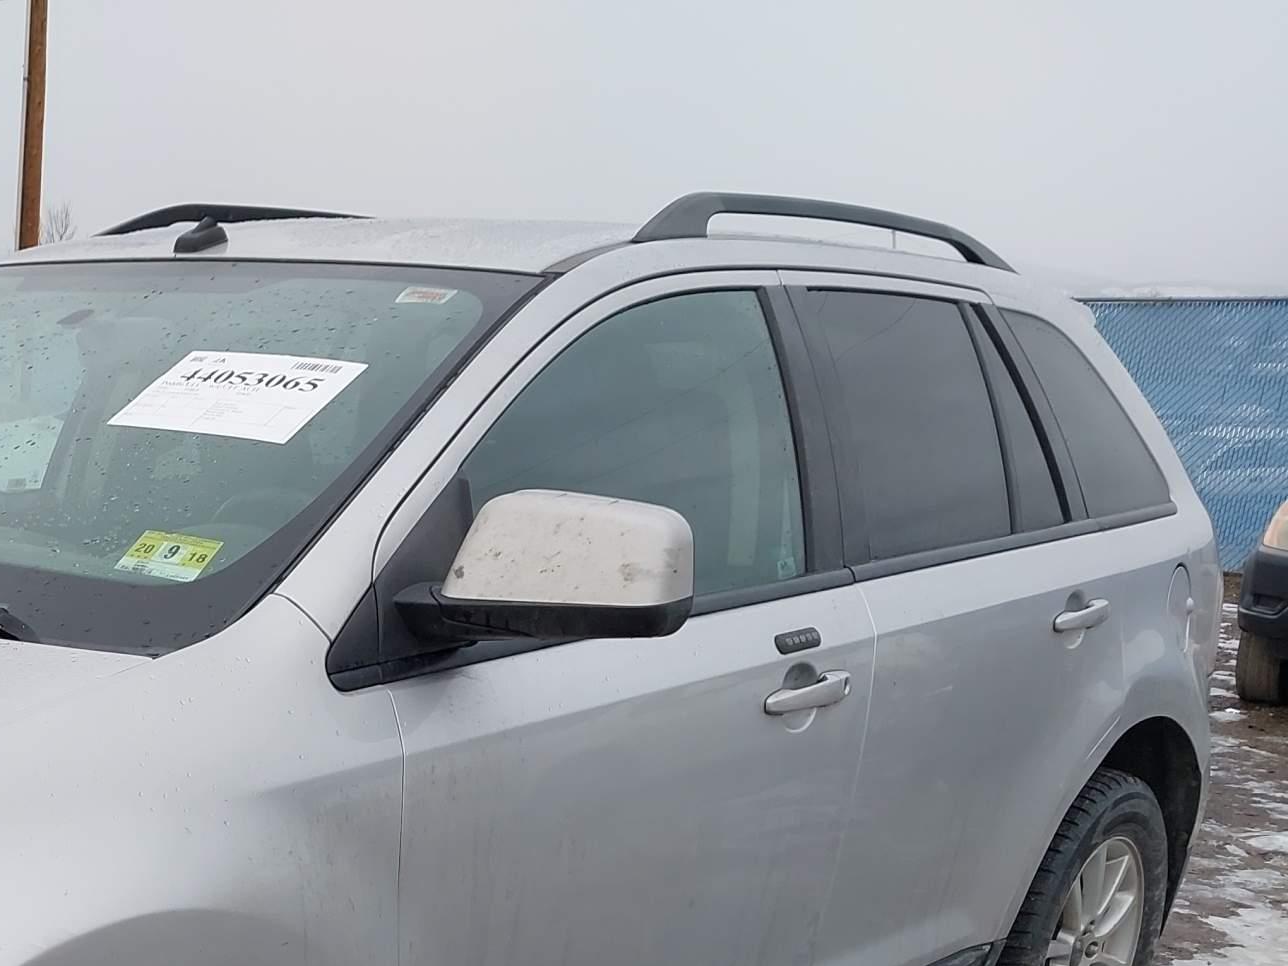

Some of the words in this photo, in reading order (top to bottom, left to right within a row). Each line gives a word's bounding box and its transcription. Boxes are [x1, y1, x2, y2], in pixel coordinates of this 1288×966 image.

[180, 368, 326, 392] 44053065
[135, 542, 155, 554] 20
[163, 545, 181, 560] 9
[189, 552, 208, 564] 18
